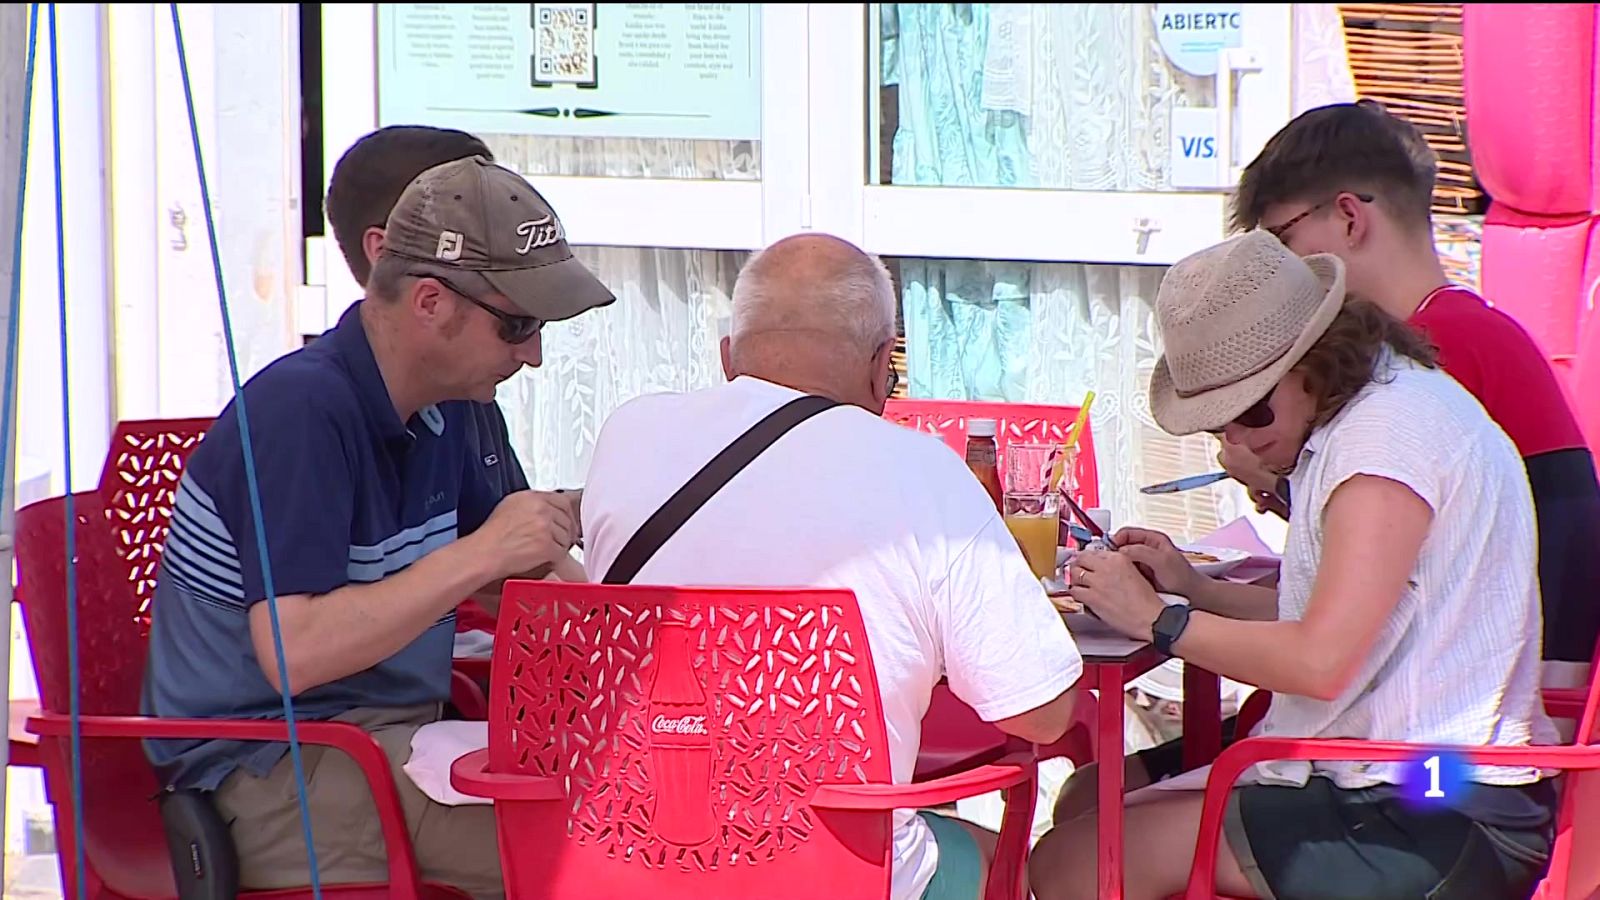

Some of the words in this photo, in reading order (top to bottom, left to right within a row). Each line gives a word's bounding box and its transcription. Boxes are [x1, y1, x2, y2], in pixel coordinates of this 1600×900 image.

[1179, 136, 1218, 159] VIS
[436, 230, 465, 261] FJ
[651, 714, 707, 735] Coca-Cola
